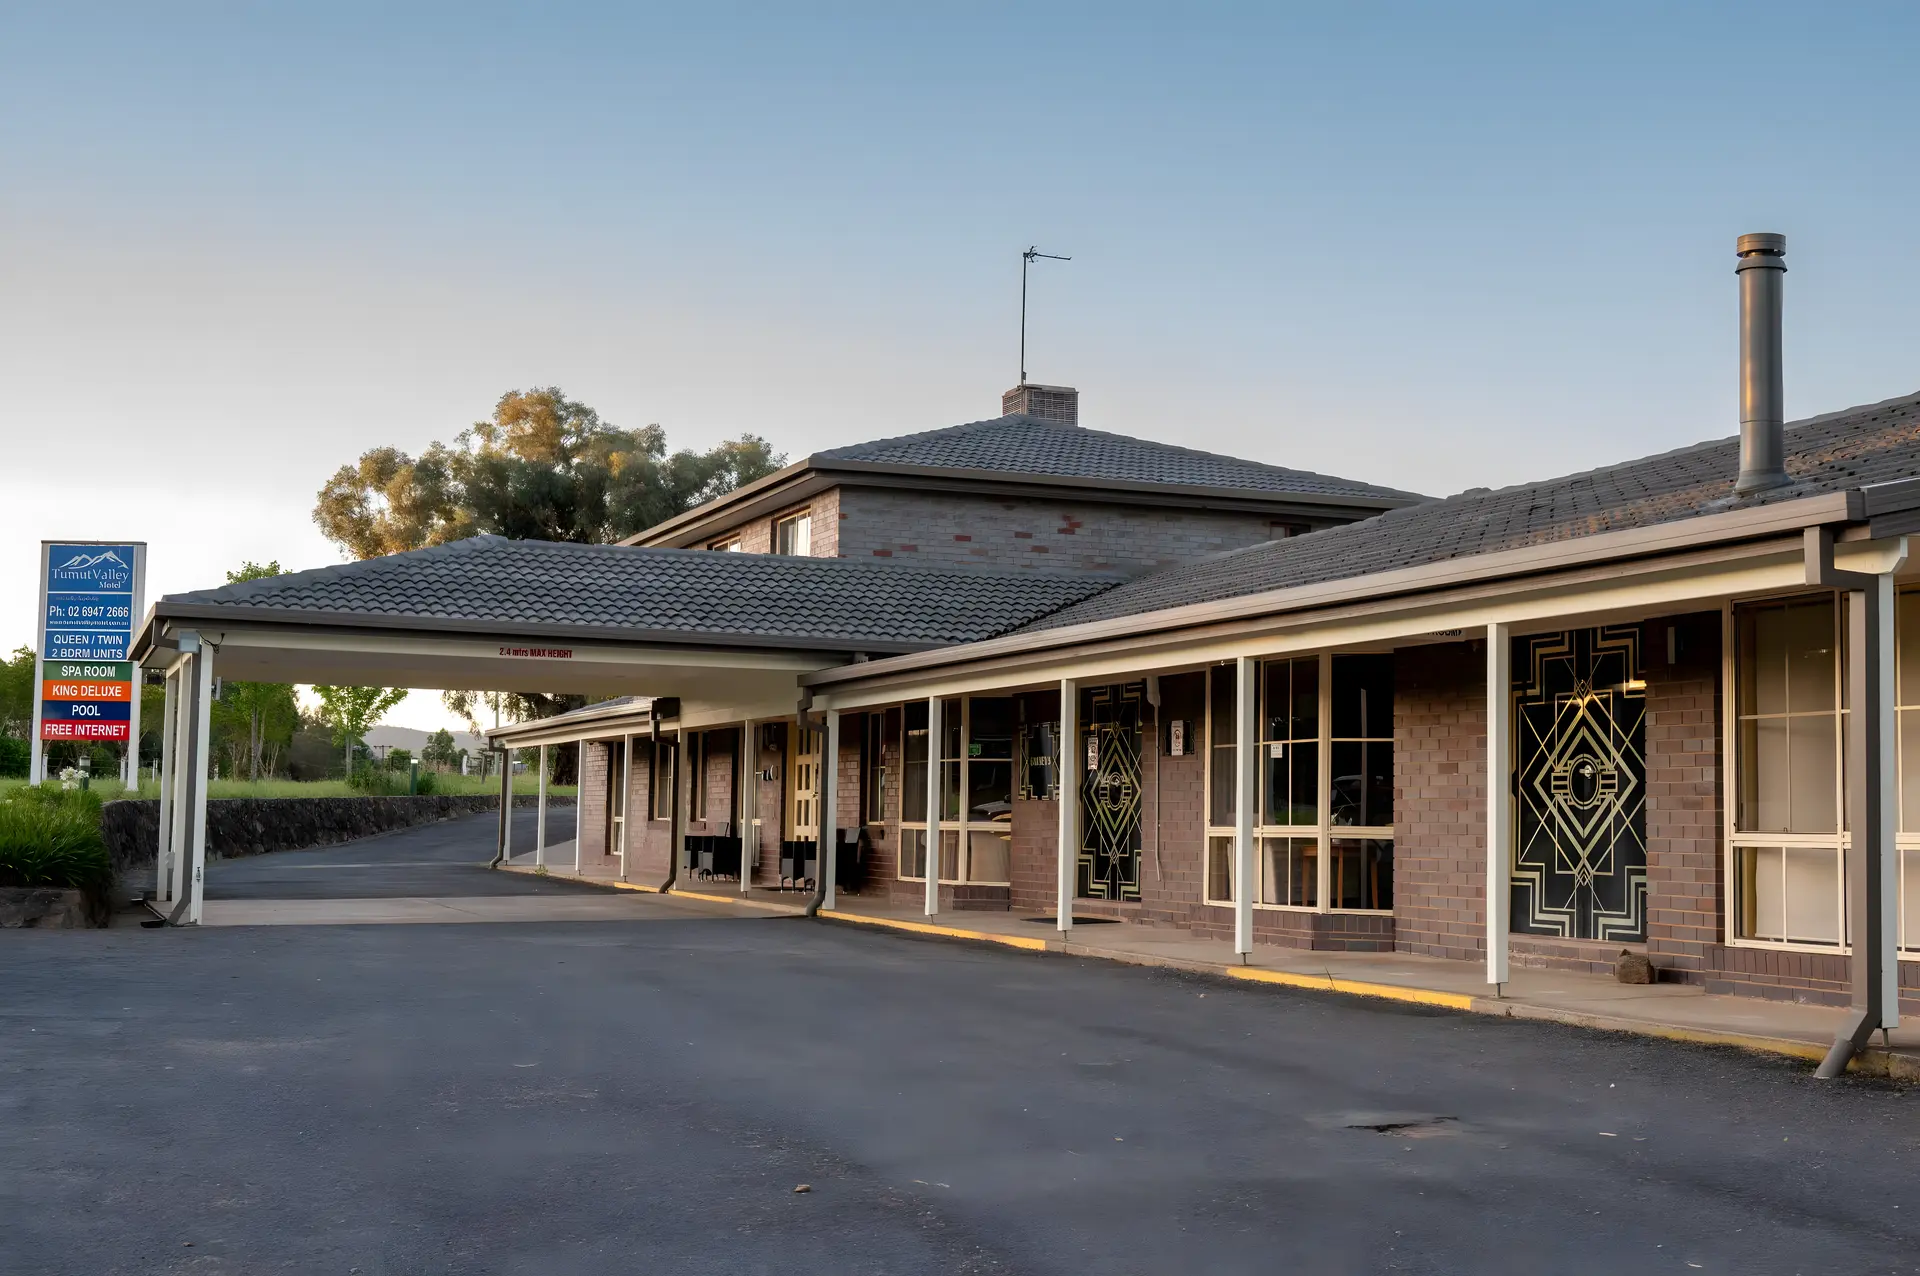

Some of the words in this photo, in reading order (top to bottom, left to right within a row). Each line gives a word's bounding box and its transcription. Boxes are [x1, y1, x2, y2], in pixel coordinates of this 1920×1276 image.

[98, 581, 121, 589] Motel
[49, 605, 65, 617] Ph:
[68, 605, 79, 617] 02
[82, 606, 104, 617] 6947
[106, 606, 129, 618] 2666
[53, 634, 89, 645] QUEEN
[97, 635, 123, 645] TWIN
[52, 648, 58, 658] 2
[60, 649, 90, 658] BDRM
[93, 649, 123, 659] UNITS
[499, 647, 511, 656] 2.4
[512, 647, 529, 657] mtrs
[530, 648, 546, 657] MAX
[547, 649, 573, 659] HEIGHT
[61, 665, 82, 677] SPA
[84, 666, 116, 678] ROOM
[52, 684, 78, 696] KING
[80, 685, 122, 697] DELUXE
[71, 704, 101, 716] POOL
[45, 723, 73, 735] FREE
[74, 724, 126, 736] INTERNET
